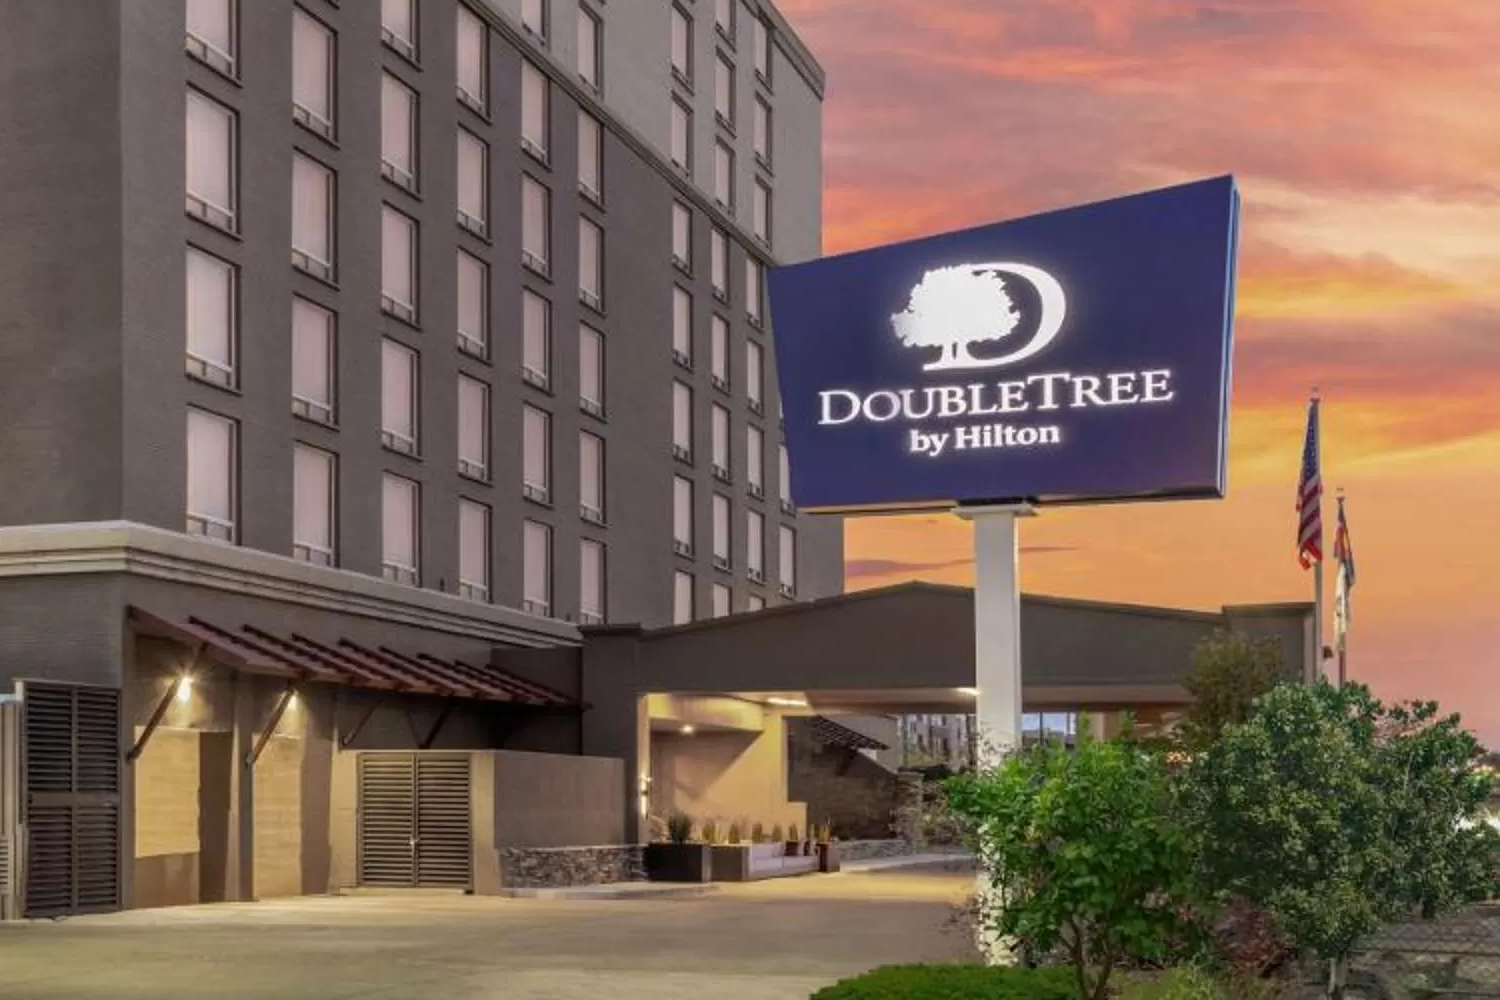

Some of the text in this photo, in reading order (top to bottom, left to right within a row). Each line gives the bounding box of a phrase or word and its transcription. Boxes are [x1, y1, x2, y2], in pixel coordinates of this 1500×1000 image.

[818, 369, 1174, 426] DOUBLETREE
[908, 423, 1060, 456] by Hilton
